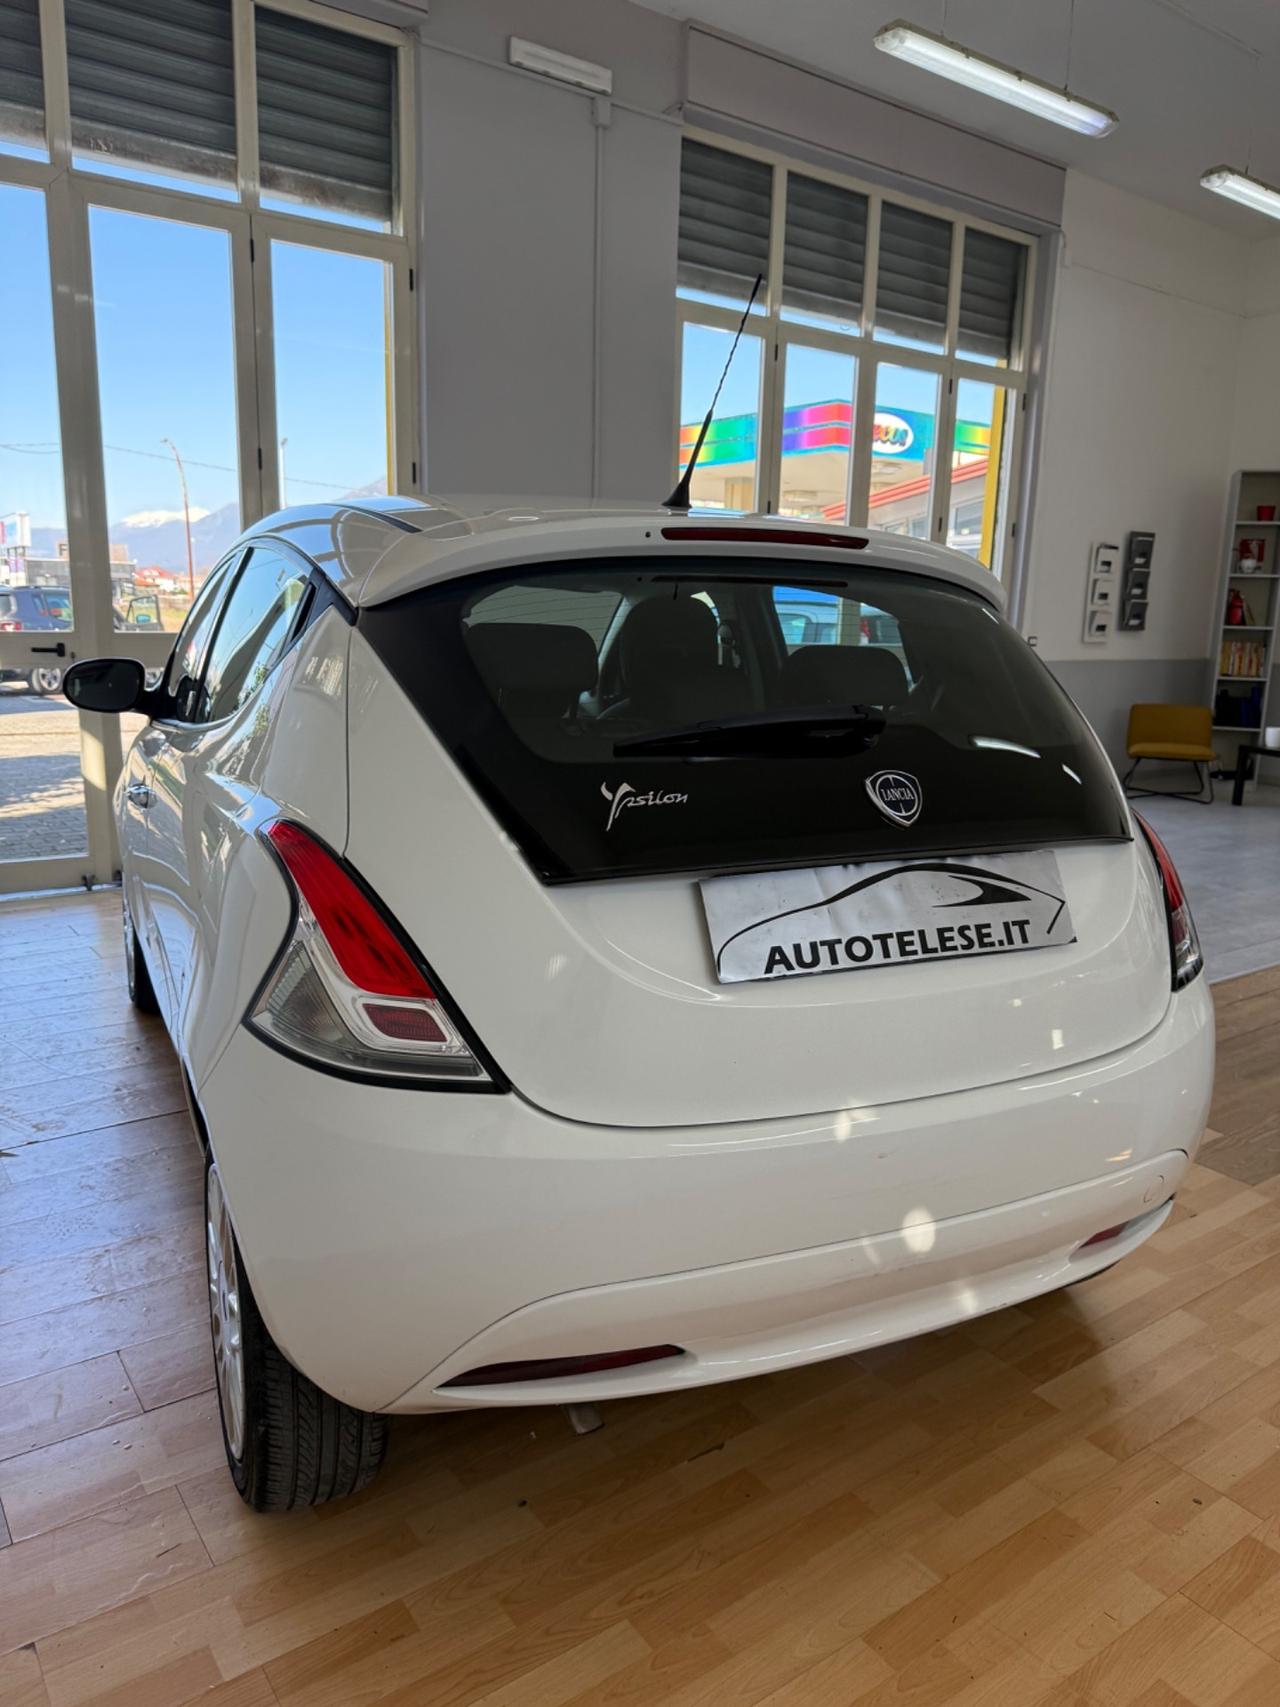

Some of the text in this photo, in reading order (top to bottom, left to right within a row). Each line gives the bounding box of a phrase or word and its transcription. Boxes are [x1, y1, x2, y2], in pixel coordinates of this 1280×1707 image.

[600, 781, 689, 831] Ypsilon
[880, 787, 915, 801] LANCIA
[764, 919, 1031, 974] AUTOTELESE.IT
